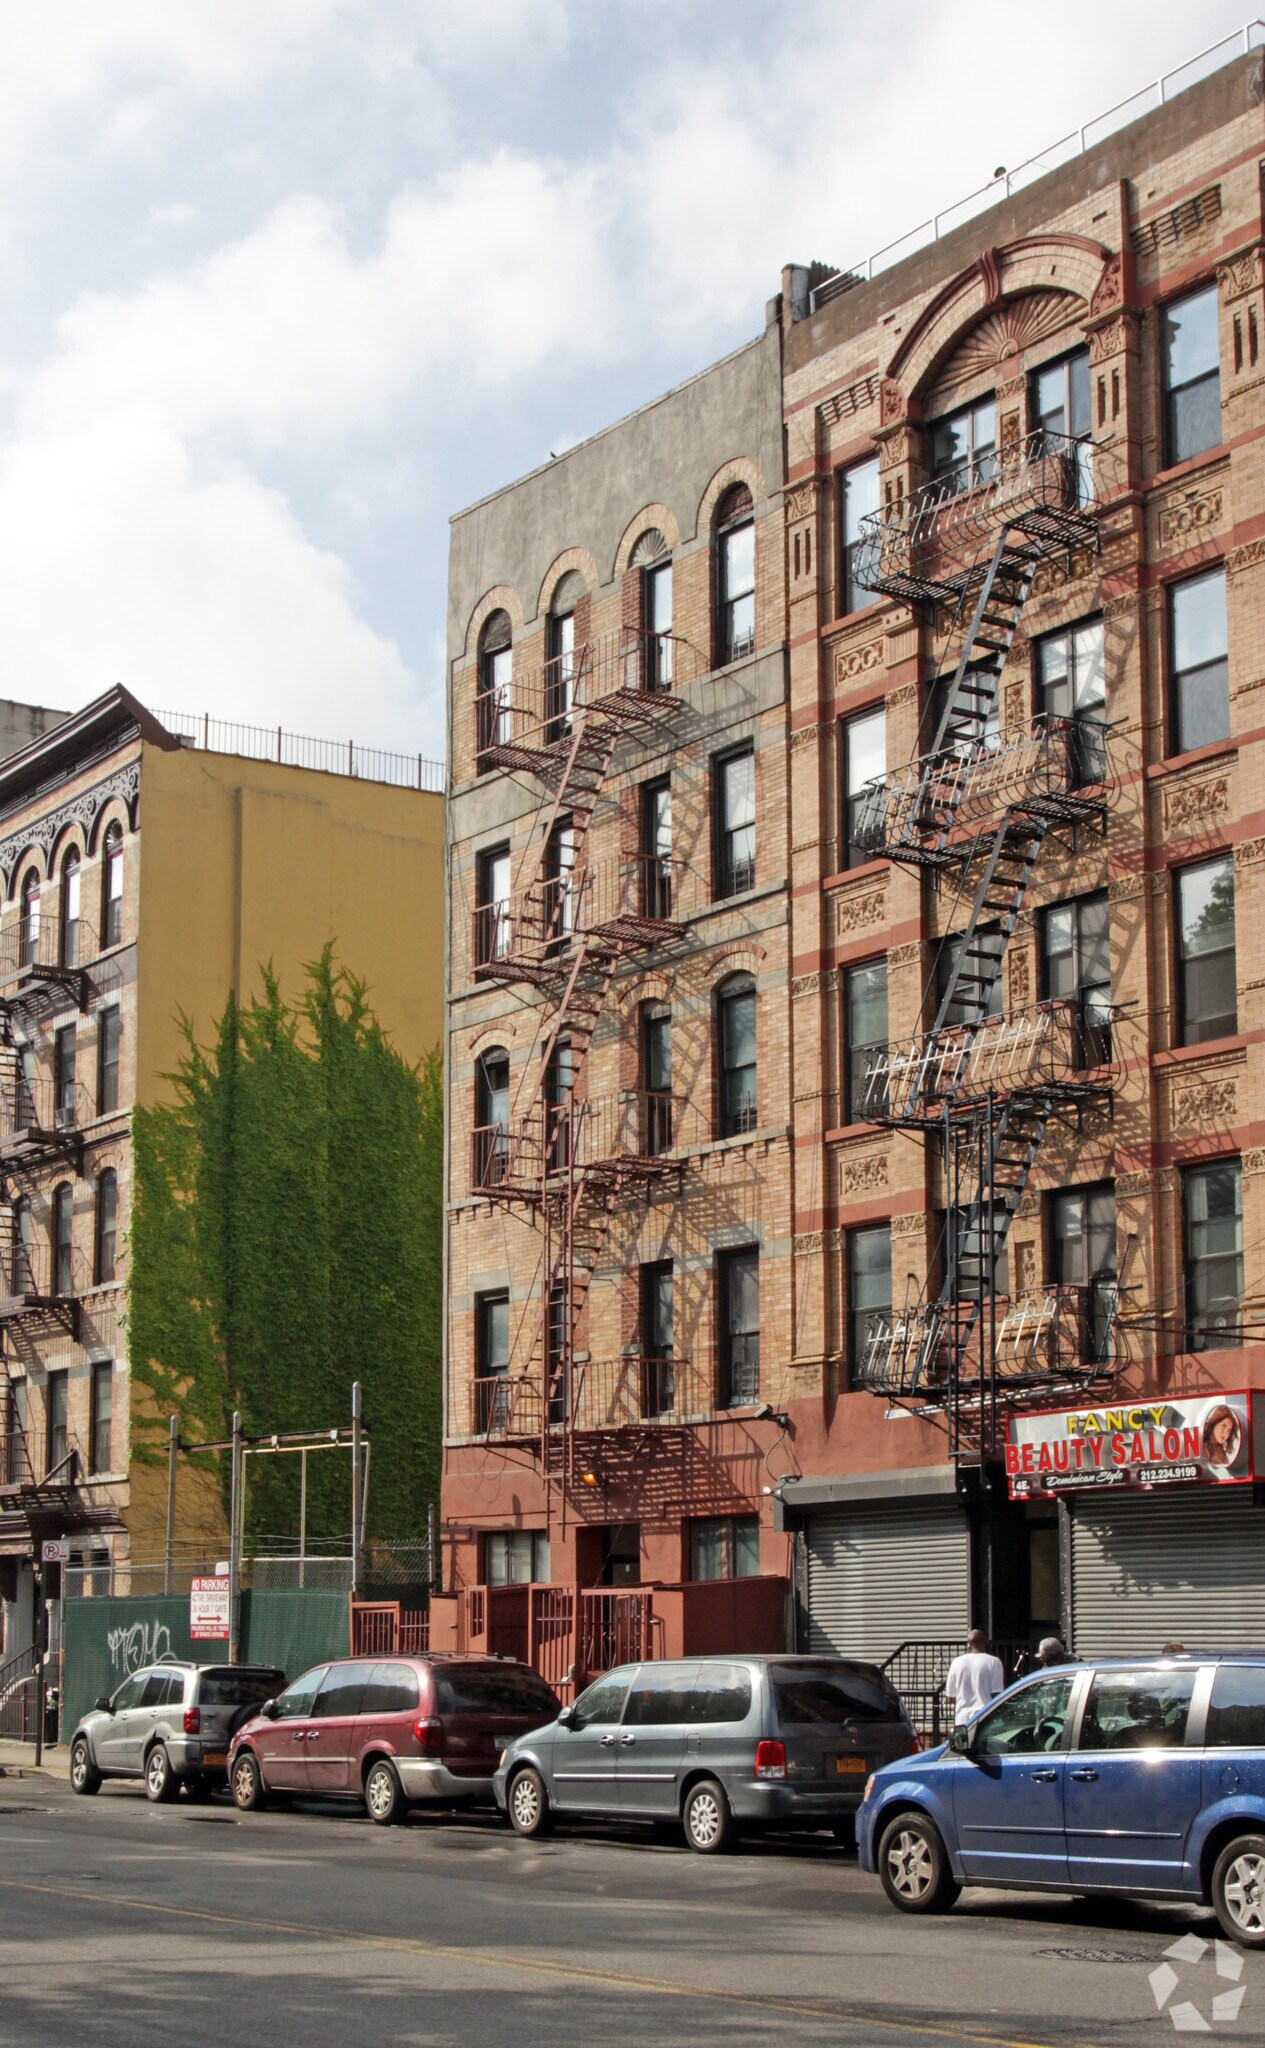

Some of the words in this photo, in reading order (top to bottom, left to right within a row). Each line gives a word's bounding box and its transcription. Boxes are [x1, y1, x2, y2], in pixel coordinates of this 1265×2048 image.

[1067, 1405, 1167, 1434] FANCY
[1005, 1435, 1105, 1475] BEAUTY
[1111, 1426, 1201, 1465] SALON
[1045, 1474, 1095, 1487] Dominican
[1096, 1469, 1123, 1484] Style
[1140, 1466, 1197, 1481] 212.234.9199
[192, 1579, 200, 1590] NO
[201, 1579, 229, 1590] PARKING
[192, 1594, 204, 1602] ACTIVE
[206, 1594, 228, 1602] DRIVEWAY
[199, 1605, 210, 1613] HOUR
[215, 1605, 227, 1613] DAYS
